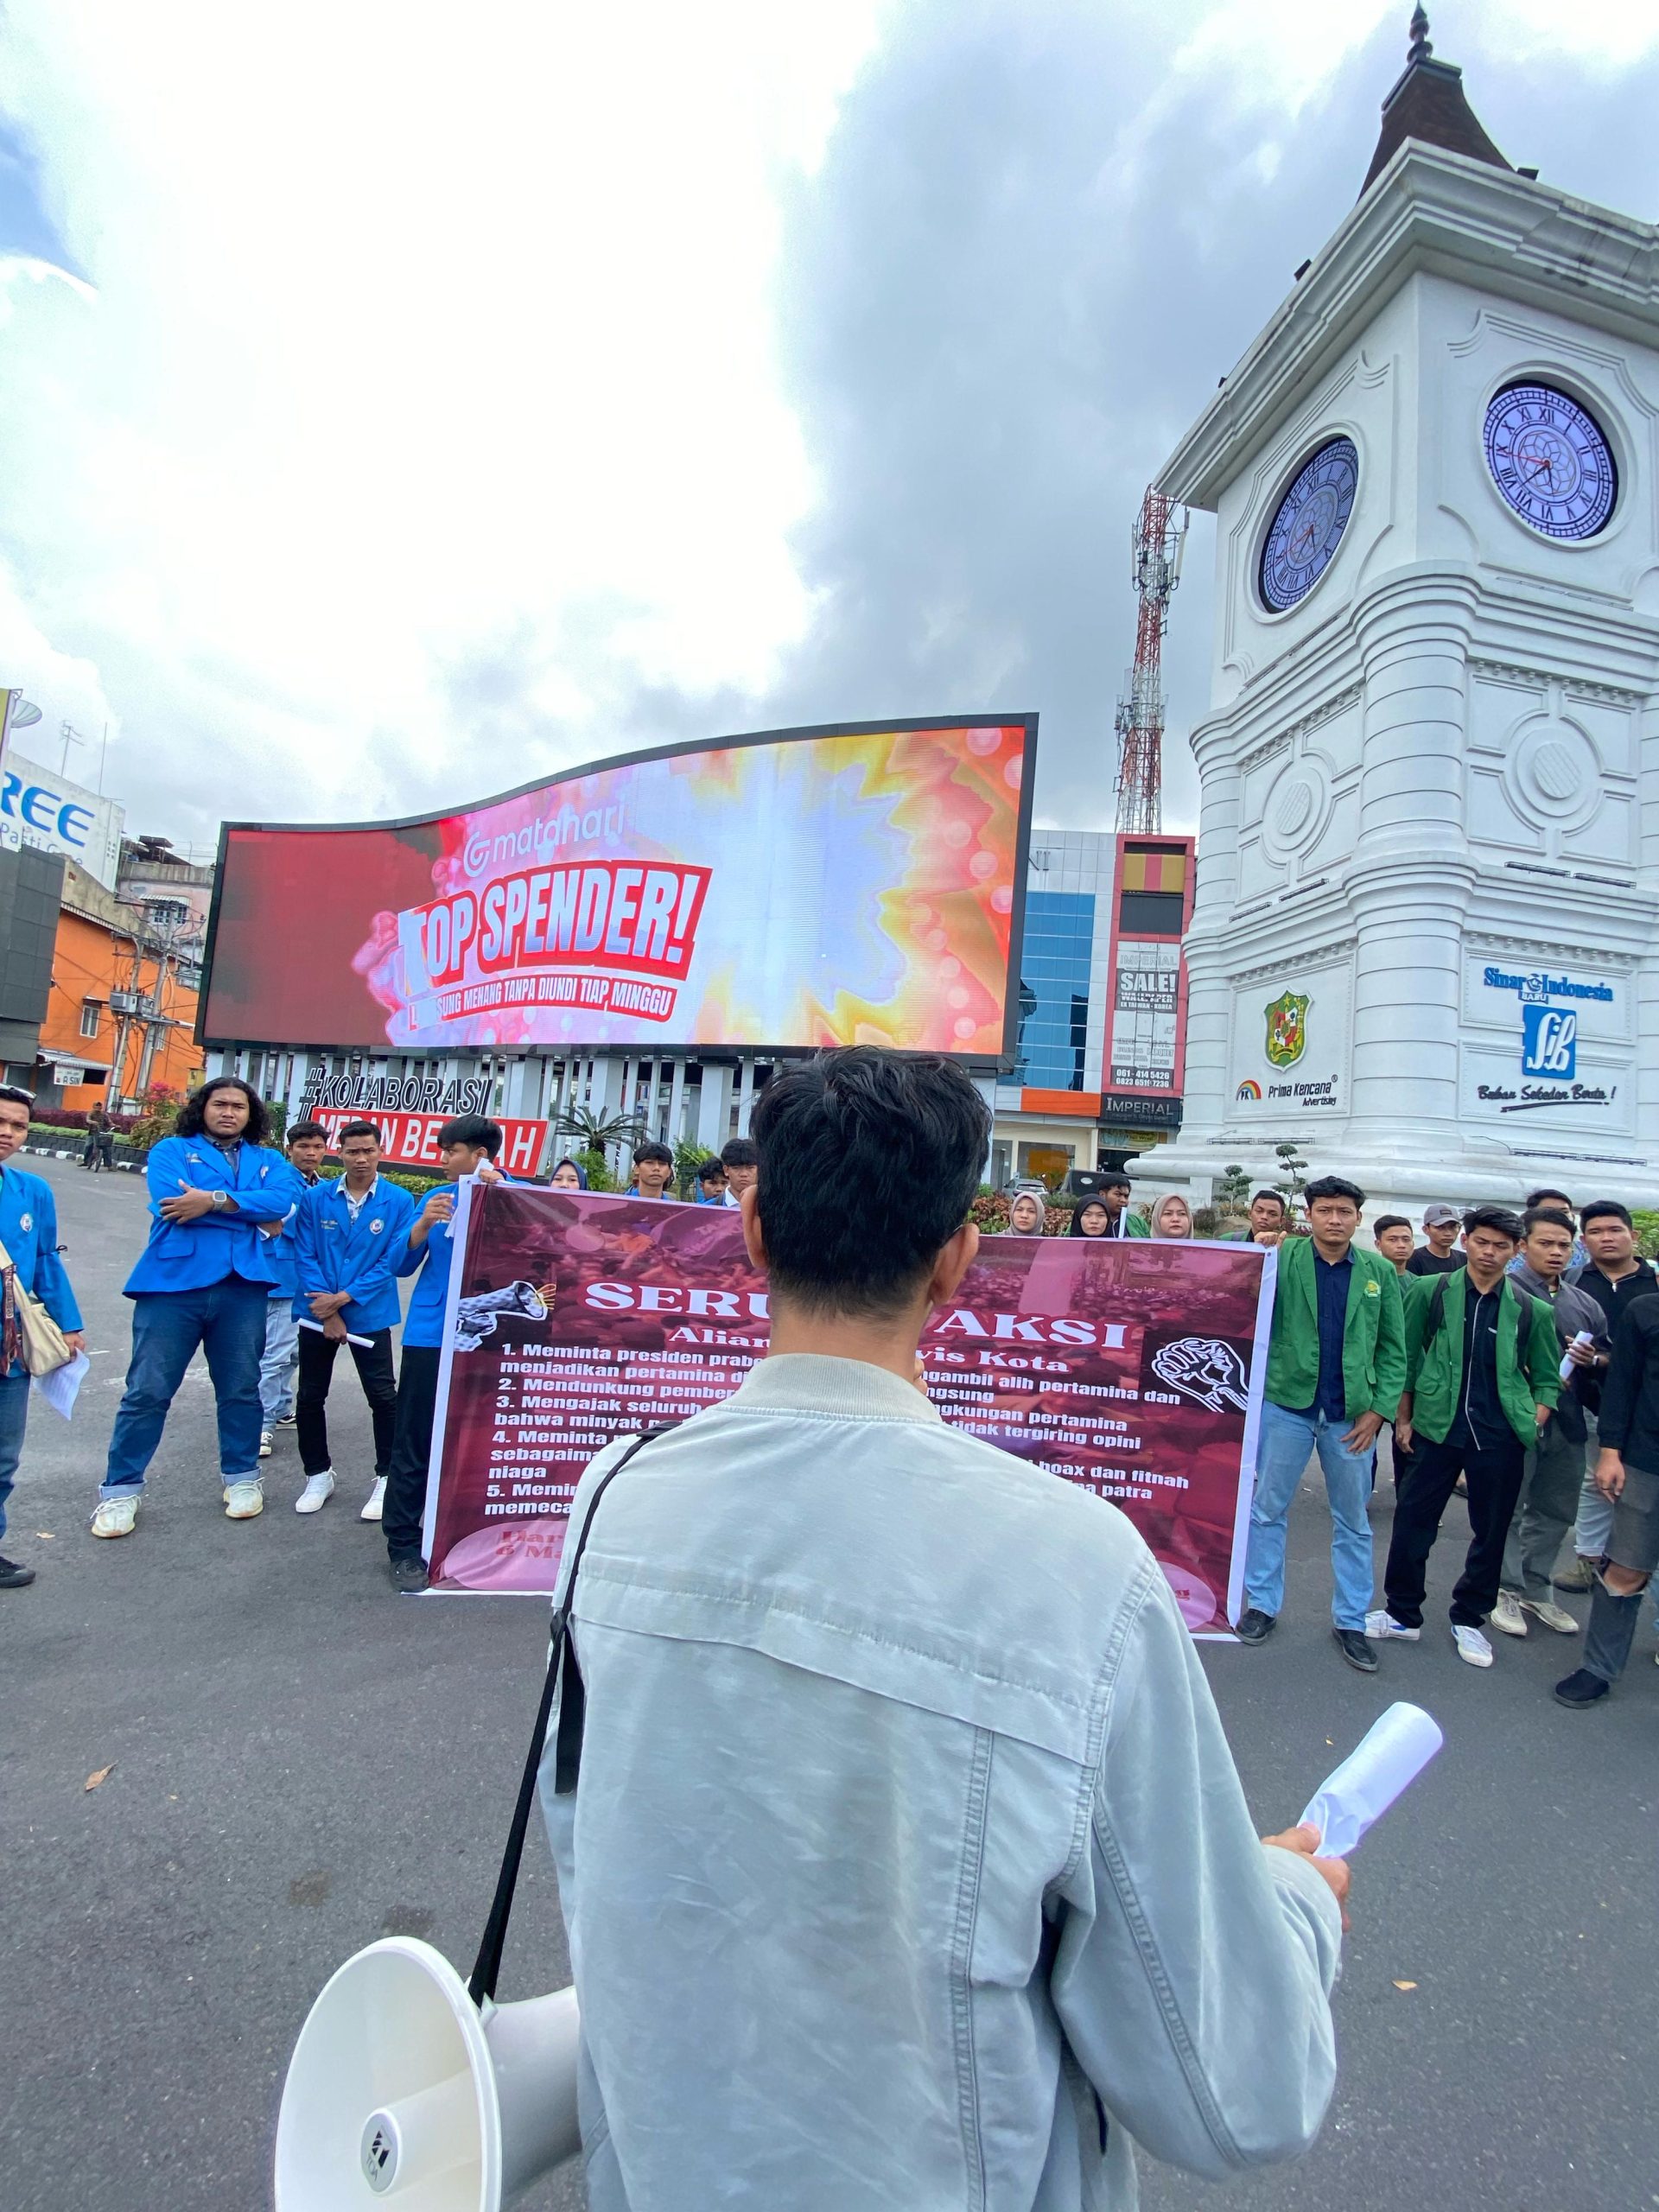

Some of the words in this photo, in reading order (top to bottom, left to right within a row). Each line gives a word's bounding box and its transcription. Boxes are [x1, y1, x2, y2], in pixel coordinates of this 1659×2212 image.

[1517, 407, 1532, 422] XI
[1539, 407, 1554, 423] XII
[1501, 420, 1515, 435] X
[1562, 423, 1572, 435] I
[1578, 445, 1591, 455] II
[1500, 467, 1517, 489] VIII
[1585, 469, 1597, 482] III
[1516, 490, 1533, 511] VII
[1580, 490, 1592, 508] IV
[1541, 505, 1554, 521] VI
[1567, 505, 1576, 520] V
[493, 804, 626, 862] matahari
[398, 894, 474, 996] TOP
[482, 868, 701, 963] SPENDER!
[1120, 954, 1177, 966] IMPERIAL
[1120, 972, 1176, 993] SALE!
[1484, 967, 1527, 990] Sinar
[1541, 974, 1613, 1001] Indonesia
[410, 993, 461, 1030] LSUNG
[464, 982, 502, 1010] MENANG
[505, 978, 536, 1002] TANPA
[538, 977, 576, 1002] DIUNDI
[581, 978, 608, 1004] TIAP
[612, 984, 672, 1015] MINGGU
[1521, 993, 1547, 1001] BARU
[297, 1068, 489, 1122] #KOLABORASI
[1268, 1084, 1292, 1098] Prima
[1294, 1082, 1332, 1096] Kencana
[1106, 1096, 1174, 1116] IMPERIAL
[1302, 1096, 1337, 1107] Advertising
[319, 1114, 398, 1155] MEN
[933, 1309, 1128, 1349] AKSI
[978, 1351, 1070, 1372] Kota
[499, 1361, 620, 1377] menjadikan
[625, 1366, 725, 1382] pertamina
[502, 1343, 517, 1356] 1.
[523, 1344, 611, 1360] Meminta
[617, 1350, 703, 1364] presiden
[999, 1376, 1033, 1390] alih
[1039, 1381, 1138, 1401] pertamina
[1144, 1390, 1180, 1405] dan
[498, 1377, 517, 1390] 2.
[1028, 1412, 1128, 1432] pertamina
[494, 1413, 563, 1426] bahwa
[569, 1414, 642, 1429] minyak
[496, 1395, 515, 1408] 3.
[521, 1395, 621, 1411] Mengajak
[1005, 1425, 1087, 1444] tergiring
[1093, 1434, 1141, 1450] opini
[492, 1430, 511, 1443] 4.
[518, 1430, 607, 1445] Meminta
[1090, 1466, 1126, 1480] dan
[1131, 1470, 1189, 1490] fitnah
[488, 1465, 547, 1479] niaga
[486, 1484, 505, 1497] 5.
[1102, 1484, 1153, 1499] patra
